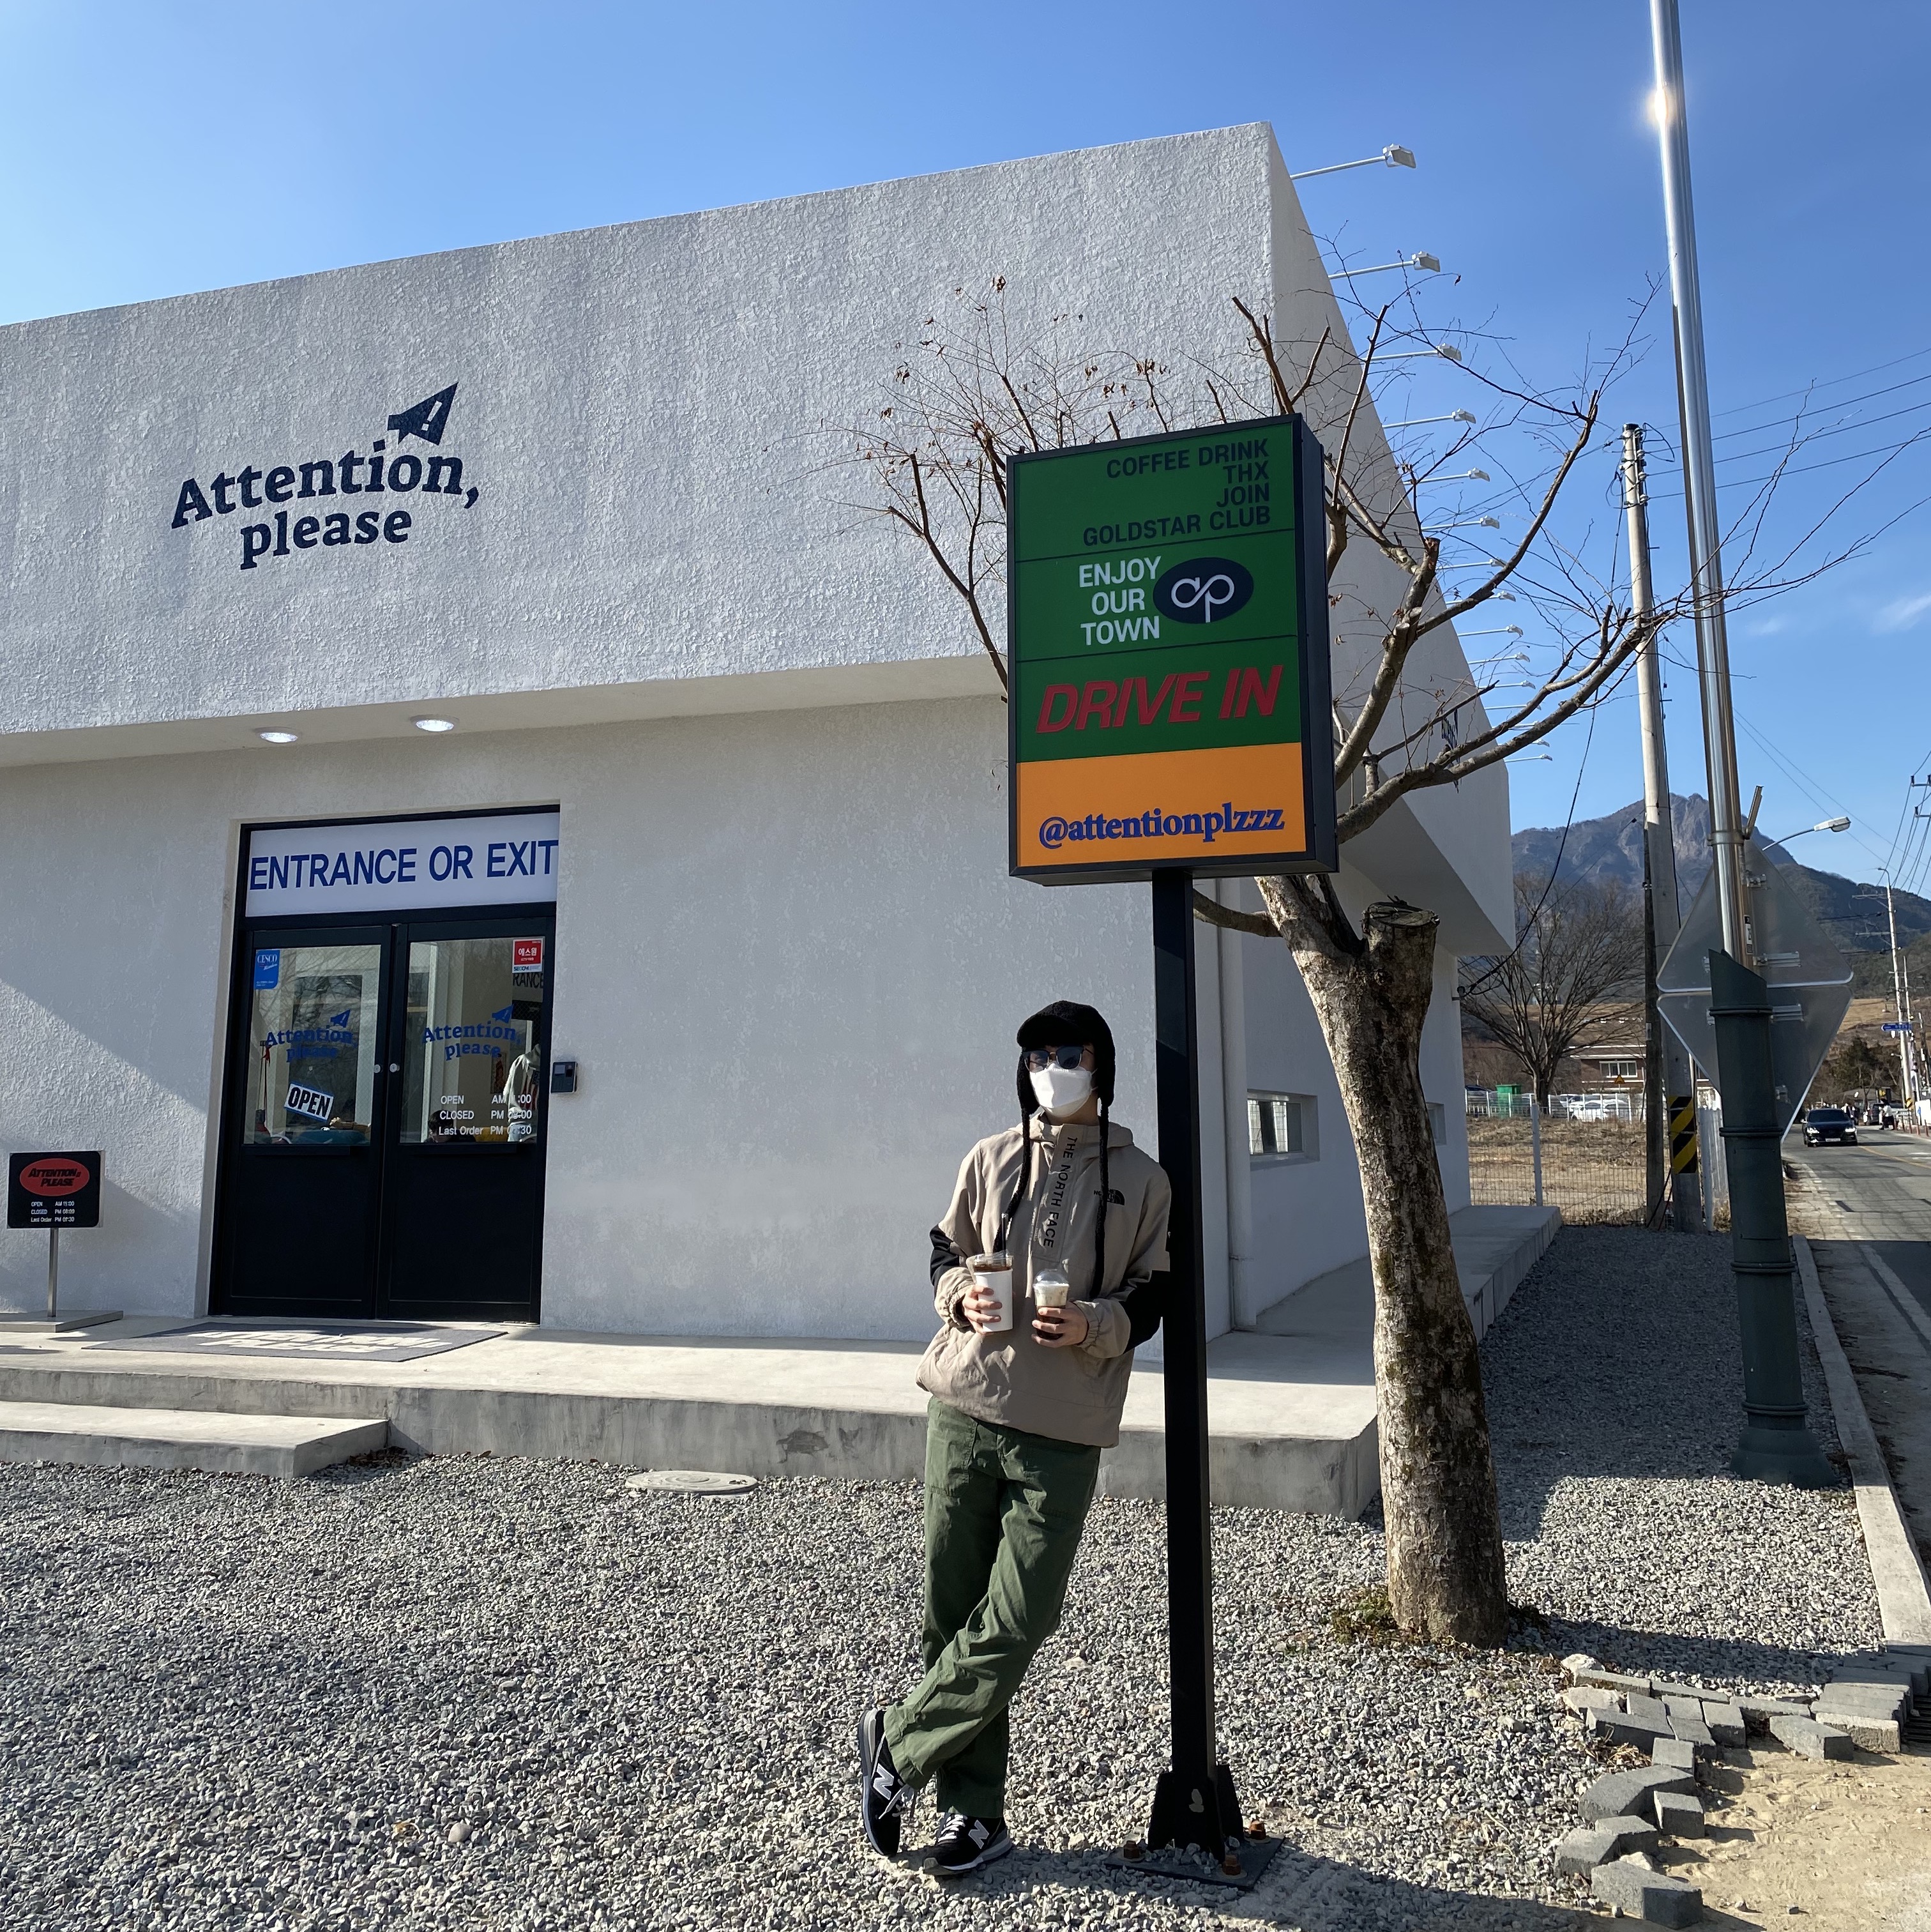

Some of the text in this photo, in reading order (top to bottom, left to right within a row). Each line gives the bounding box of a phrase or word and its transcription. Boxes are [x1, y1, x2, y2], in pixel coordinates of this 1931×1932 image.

[1107, 438, 1269, 478] COFFEE DRINK
[1223, 460, 1269, 484] THX
[171, 439, 479, 529] Attention,
[1216, 482, 1269, 508] JOIN
[240, 510, 412, 570] please
[1083, 505, 1271, 547] GOLDSTAR CLUB
[1079, 556, 1162, 588] ENJOY
[1091, 588, 1145, 616] OUR
[1080, 616, 1160, 646] TOWN
[1035, 664, 1284, 734] DRIVE IN
[1038, 802, 1285, 850] @attentionplzzz
[249, 839, 559, 891] ENTRANCE OR EXIT
[444, 1042, 502, 1061] please
[288, 1087, 331, 1118] OPEN
[440, 1095, 464, 1104] OPEN
[491, 1094, 506, 1104] AM
[438, 1126, 457, 1136] Last
[459, 1125, 483, 1136] Order
[490, 1125, 504, 1135] PM
[439, 1110, 474, 1120] CLOSED
[490, 1110, 504, 1119] PM
[1043, 1136, 1078, 1249] THE NORTH FACE
